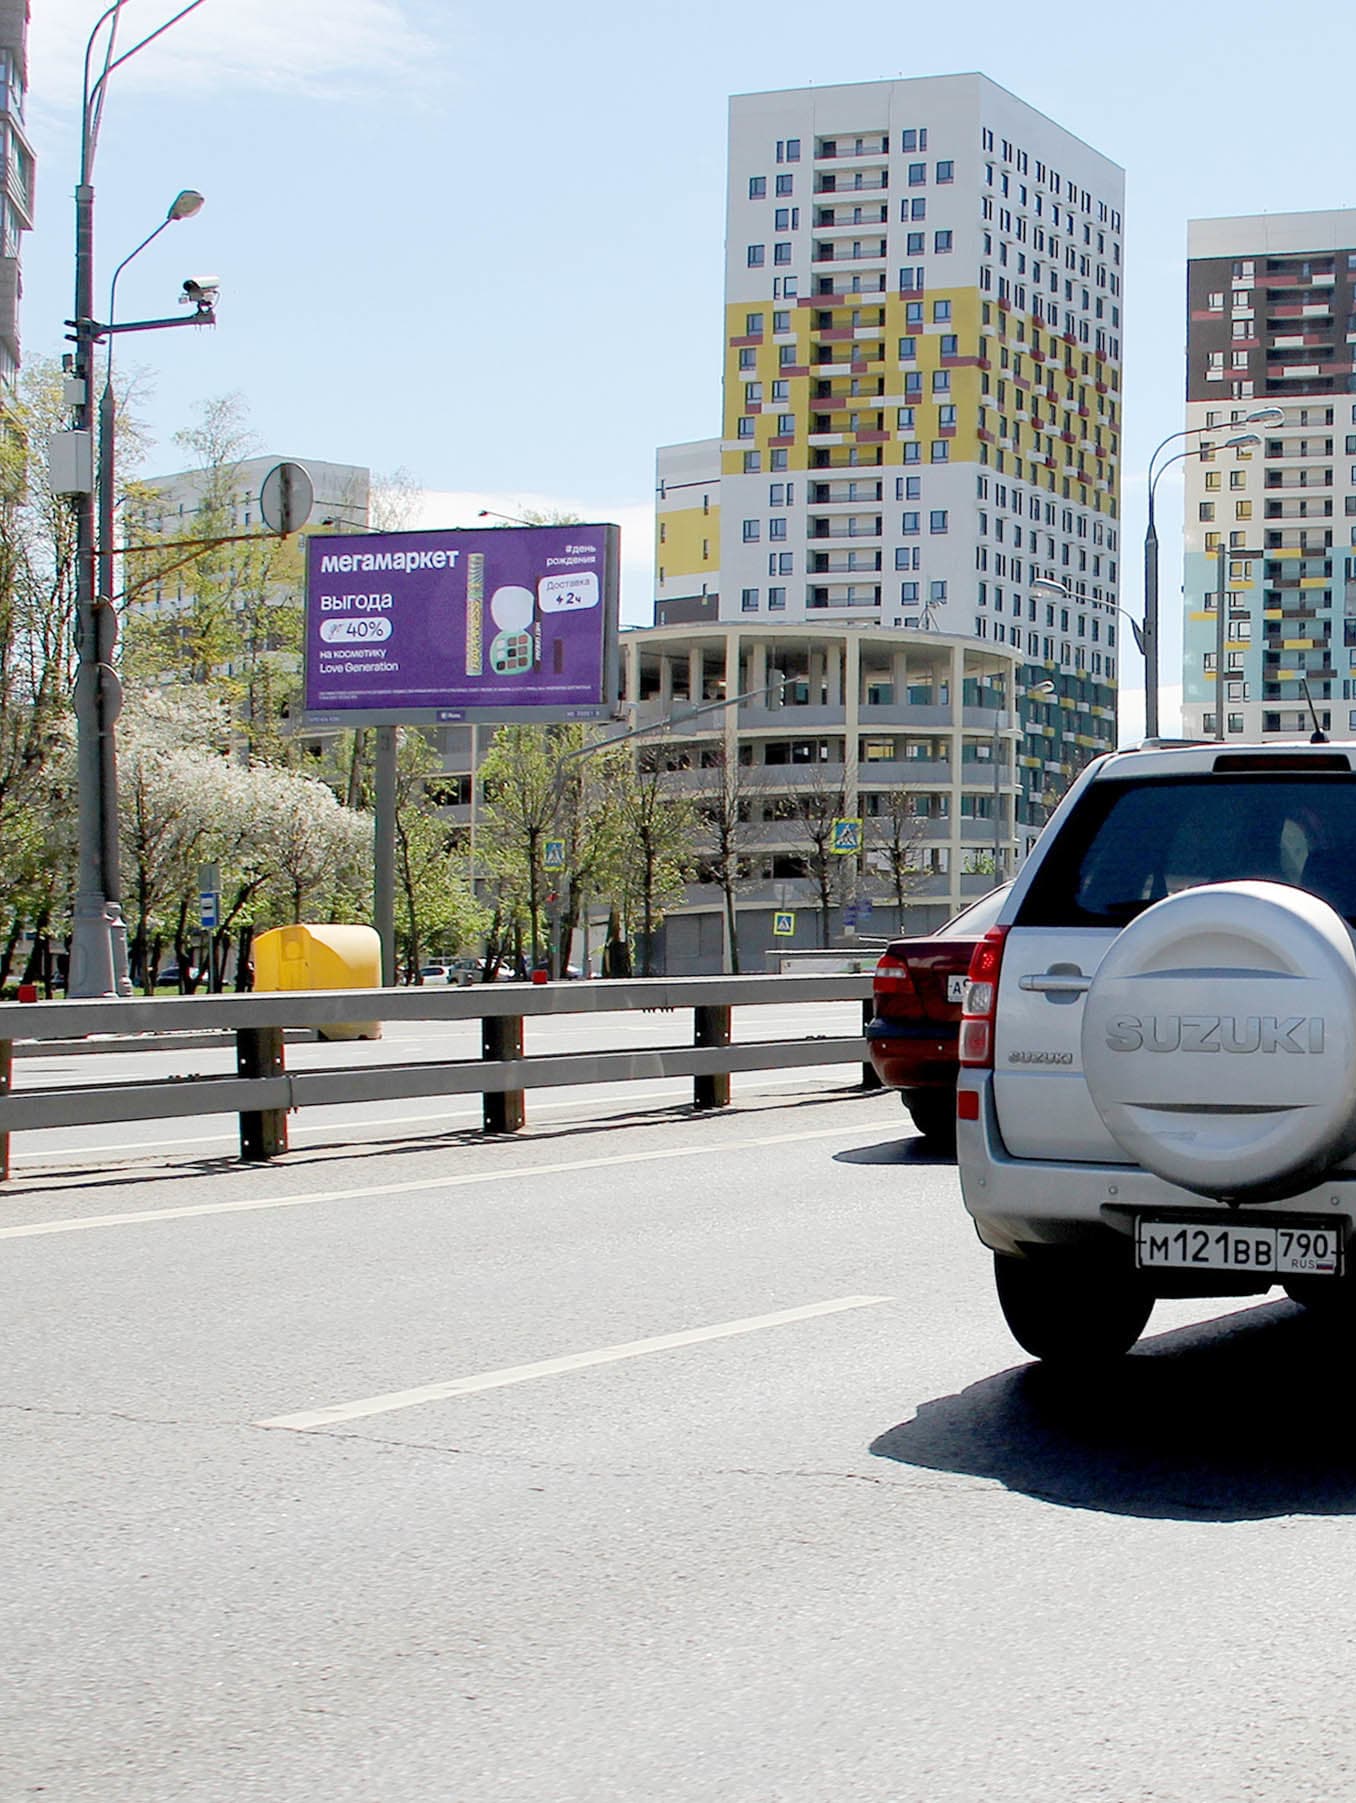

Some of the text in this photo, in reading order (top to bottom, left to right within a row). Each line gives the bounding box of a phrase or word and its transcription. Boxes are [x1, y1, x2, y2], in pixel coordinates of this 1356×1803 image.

[321, 550, 459, 573] мегамаркет
[547, 579, 590, 592] Доставка
[321, 593, 393, 613] выгода
[346, 621, 384, 637] 40%
[320, 648, 387, 659] на косметику
[320, 660, 399, 674] Love Generation
[1105, 1015, 1325, 1054] SUZUKI
[1008, 1051, 1073, 1065] SUZUKI
[1150, 1229, 1329, 1266] М121ВВ 790
[1291, 1258, 1316, 1270] RUS
